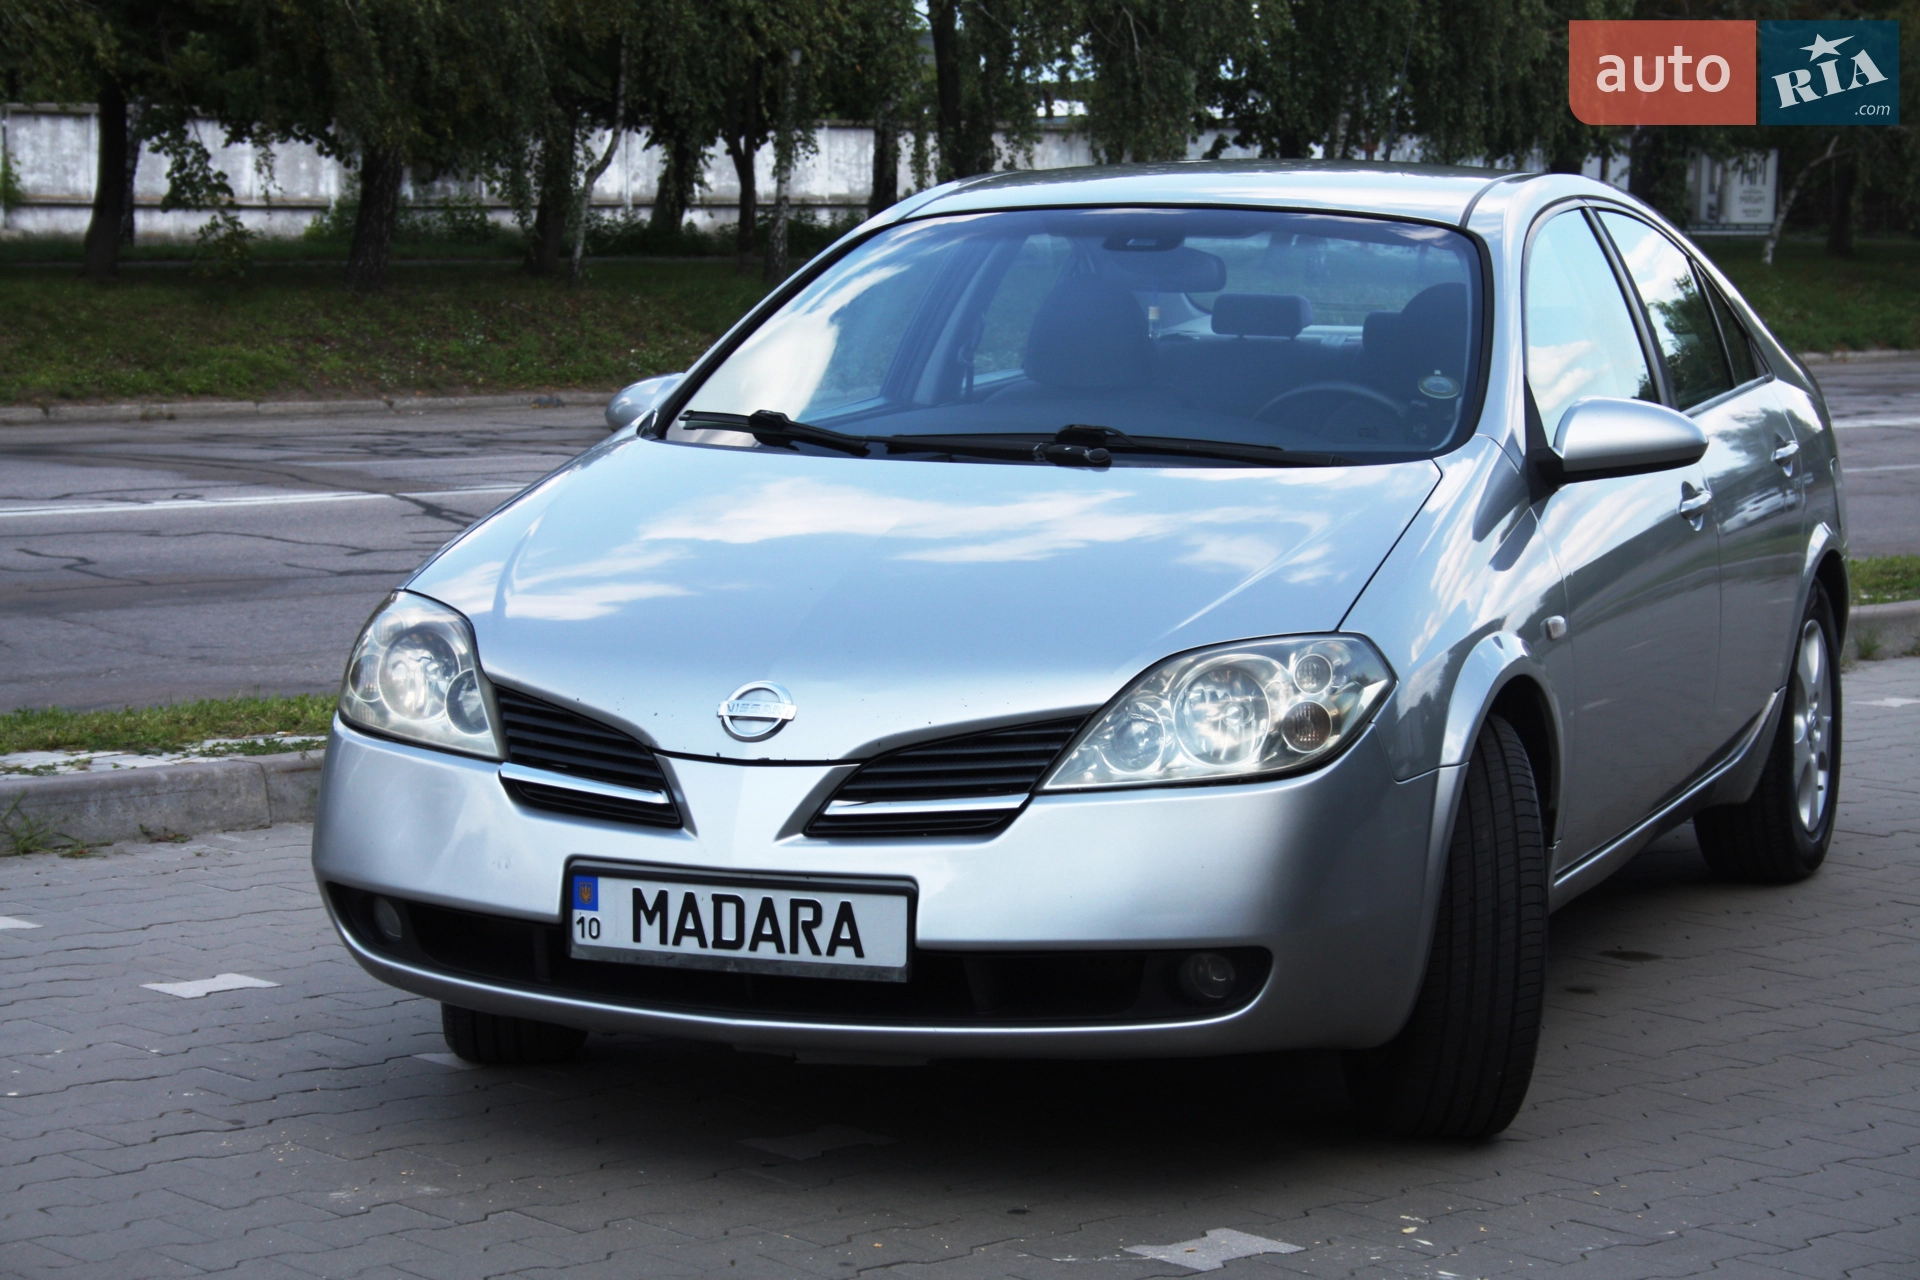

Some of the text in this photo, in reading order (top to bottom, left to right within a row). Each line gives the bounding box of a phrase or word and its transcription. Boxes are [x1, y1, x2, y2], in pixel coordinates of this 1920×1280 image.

[725, 702, 782, 715] NISSAN
[576, 915, 601, 940] 10
[631, 887, 865, 958] MADARA
